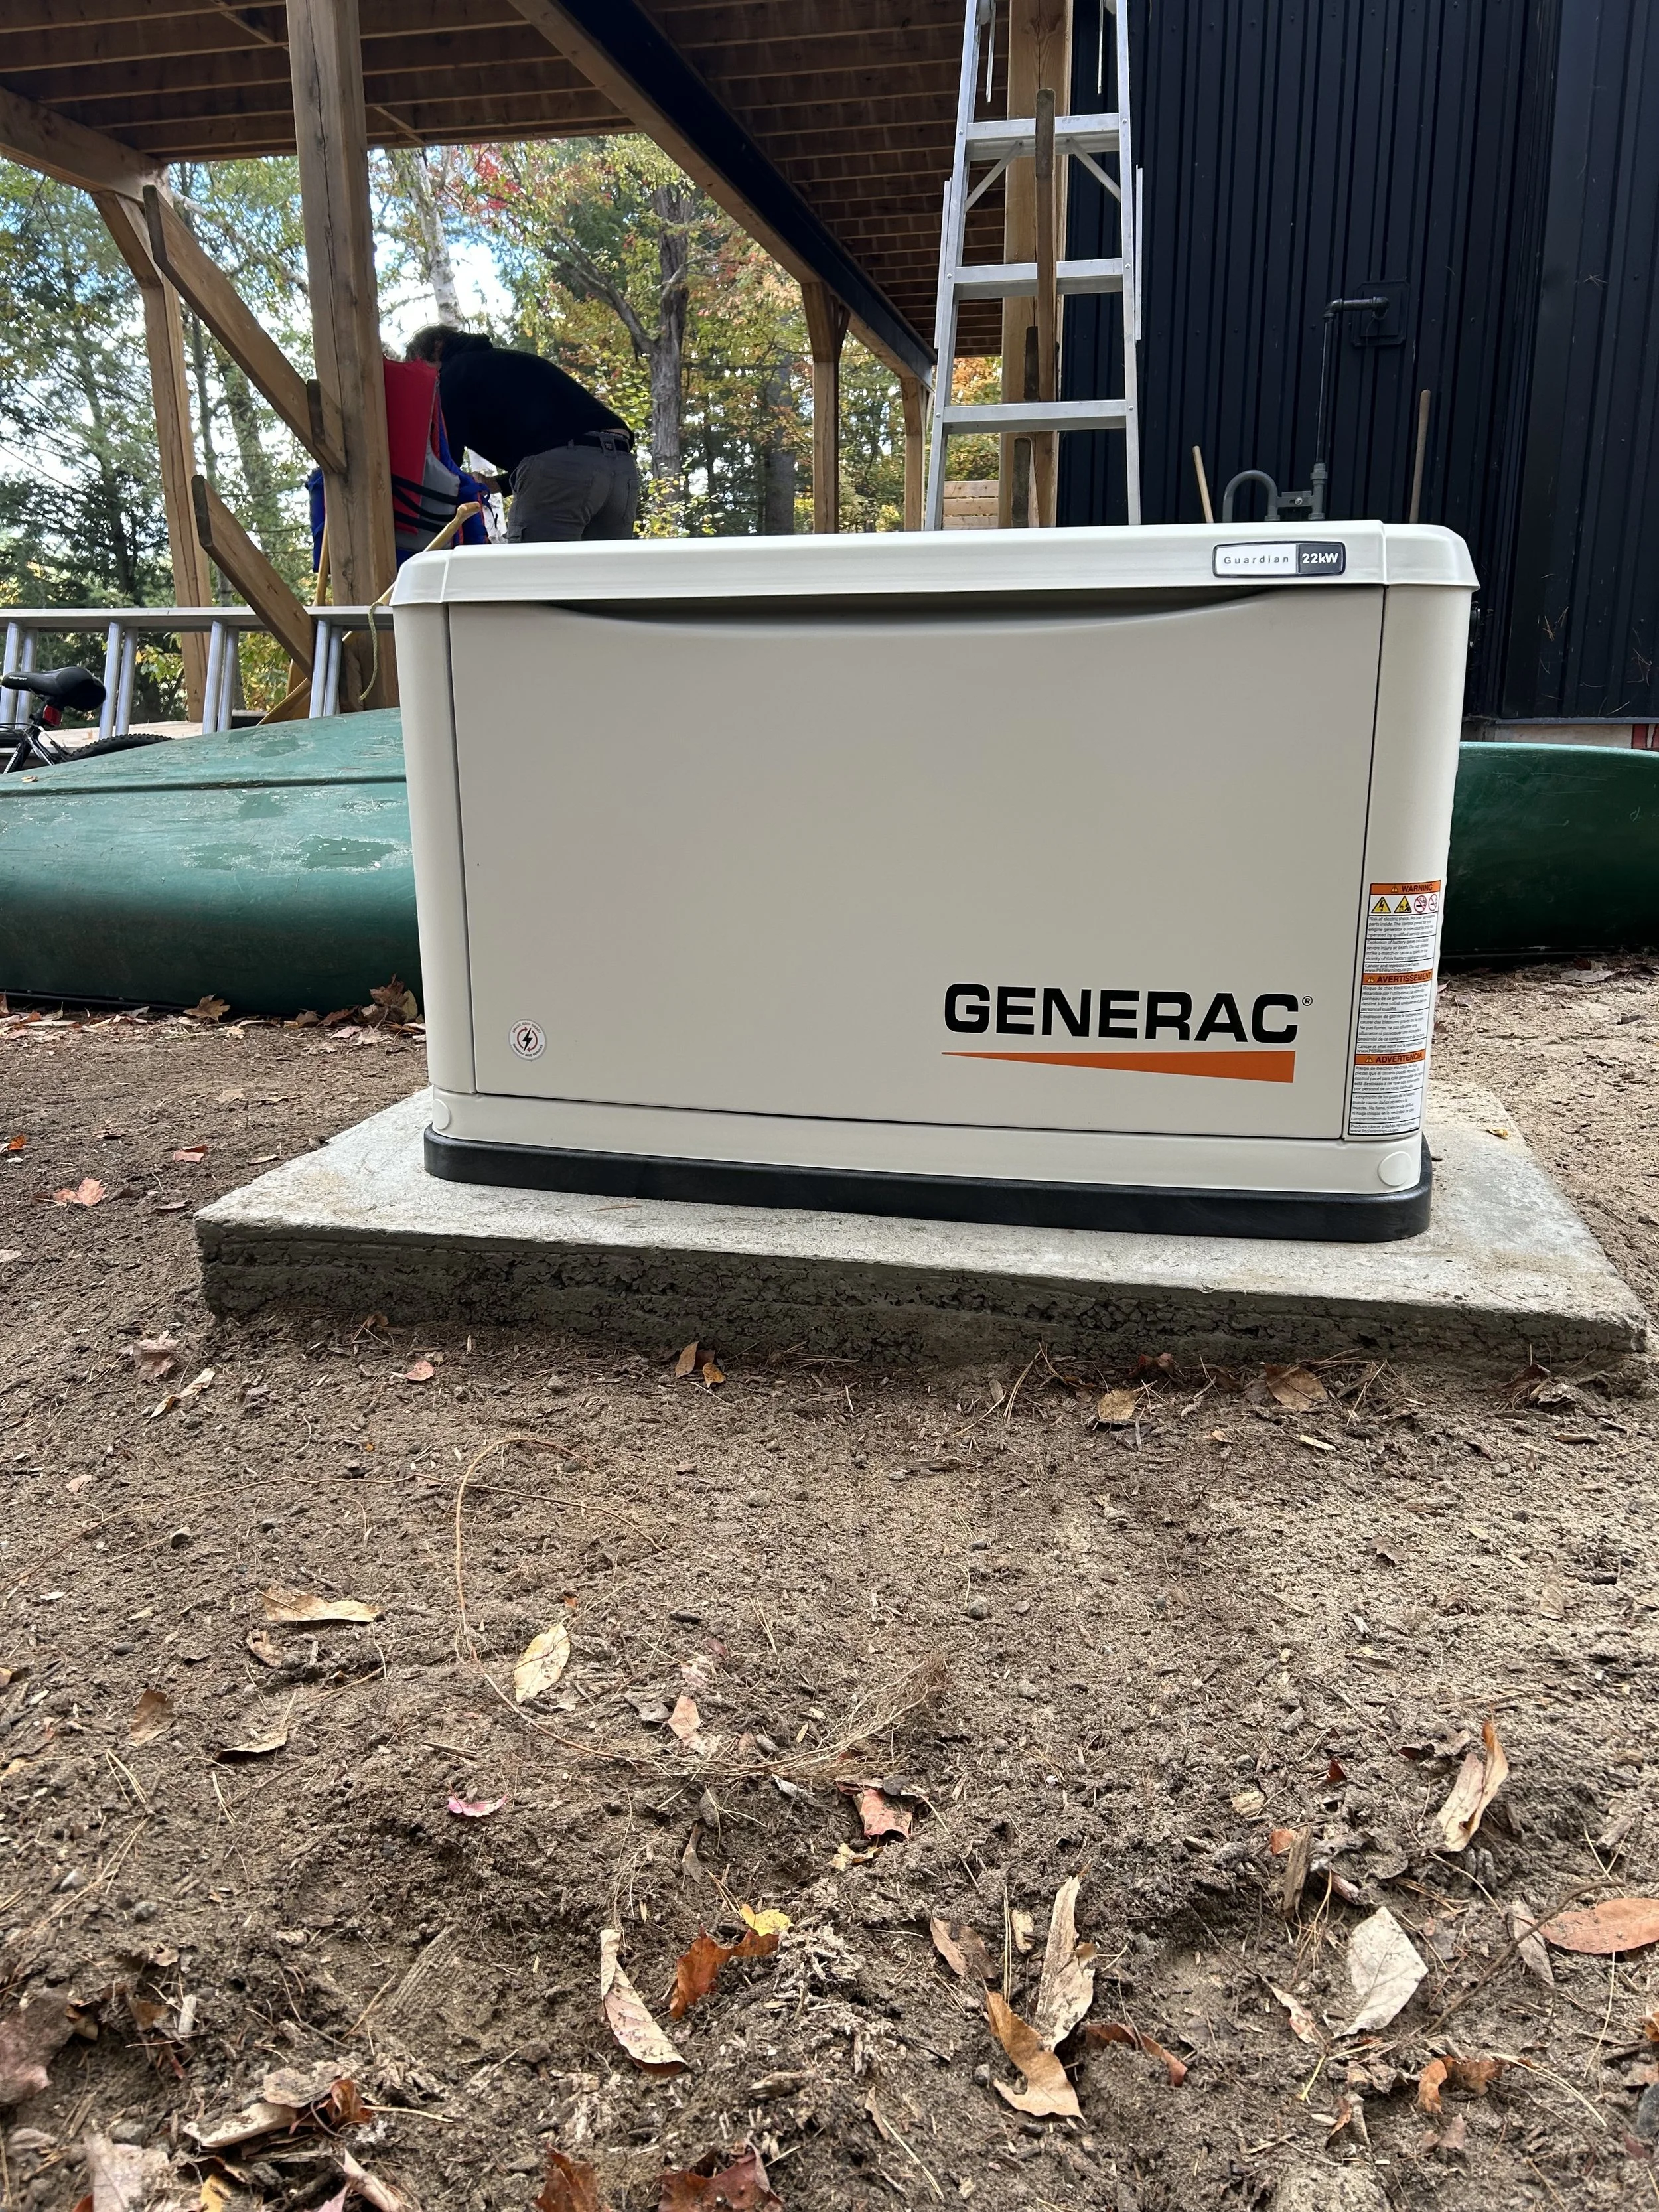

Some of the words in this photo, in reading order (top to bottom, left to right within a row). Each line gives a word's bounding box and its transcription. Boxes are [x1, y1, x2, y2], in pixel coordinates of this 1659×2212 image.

[1224, 555, 1289, 564] Guardian
[1302, 553, 1339, 563] 22kW
[1377, 972, 1431, 982] AVERTISSEMENT
[1376, 1052, 1422, 1063] ADVERTENCIA
